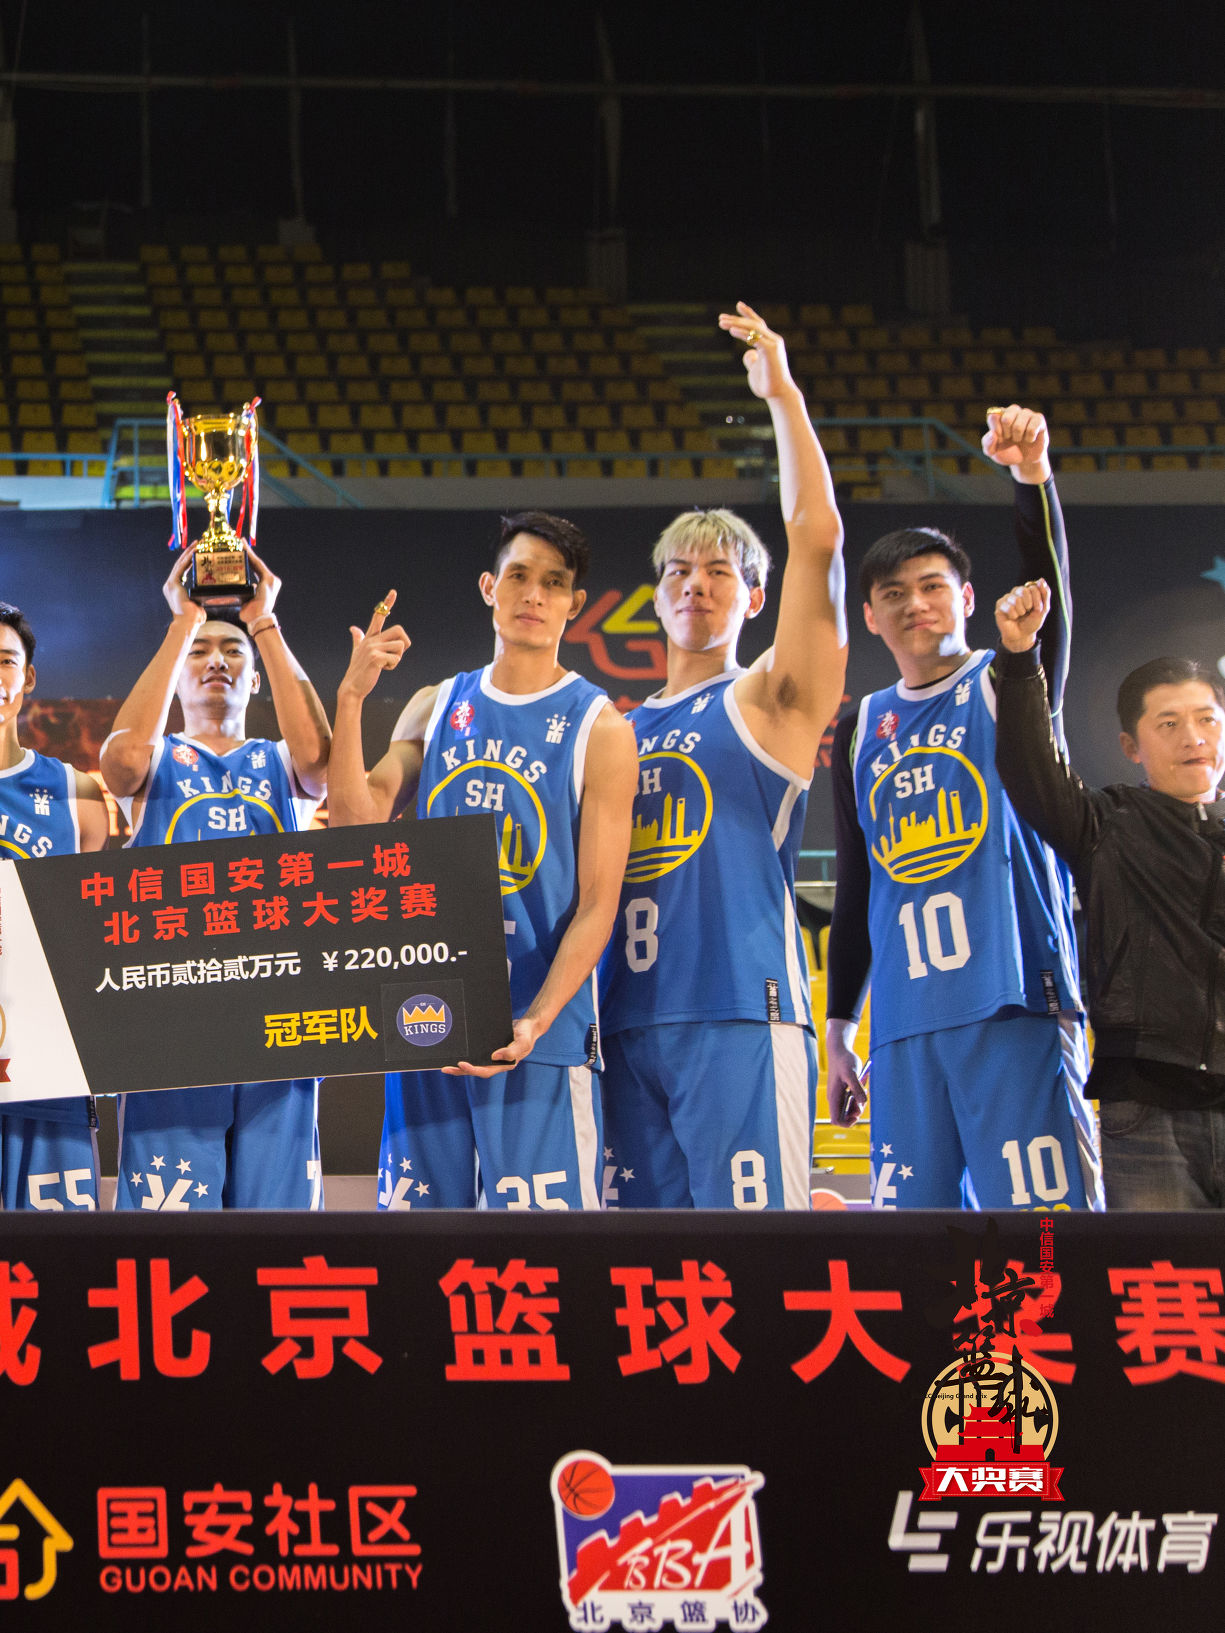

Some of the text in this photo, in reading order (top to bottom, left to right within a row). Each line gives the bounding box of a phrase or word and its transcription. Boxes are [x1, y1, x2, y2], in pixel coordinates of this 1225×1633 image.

[442, 738, 547, 784] KINGS
[638, 728, 701, 755] NGS
[177, 771, 272, 801] KINGS
[465, 779, 505, 812] SH
[637, 767, 662, 796] H
[893, 764, 936, 799] SH
[208, 805, 247, 832] SH
[81, 842, 412, 907] 中信国安第一城
[104, 883, 437, 945] 北京篮球大奖赛
[625, 897, 659, 973] 8
[898, 891, 972, 980] 10
[95, 952, 301, 992] 人民币贰拾贰万元
[264, 1006, 379, 1049] 冠军队
[403, 1023, 446, 1036] KINGS
[730, 1149, 767, 1211] 8
[1001, 1135, 1069, 1206] 10
[96, 1482, 422, 1559] 国安社区
[971, 1511, 1219, 1574] 乐视体育
[99, 1563, 423, 1593] GUOAN COMMUNITY
[576, 1601, 761, 1625] 北京篮协
